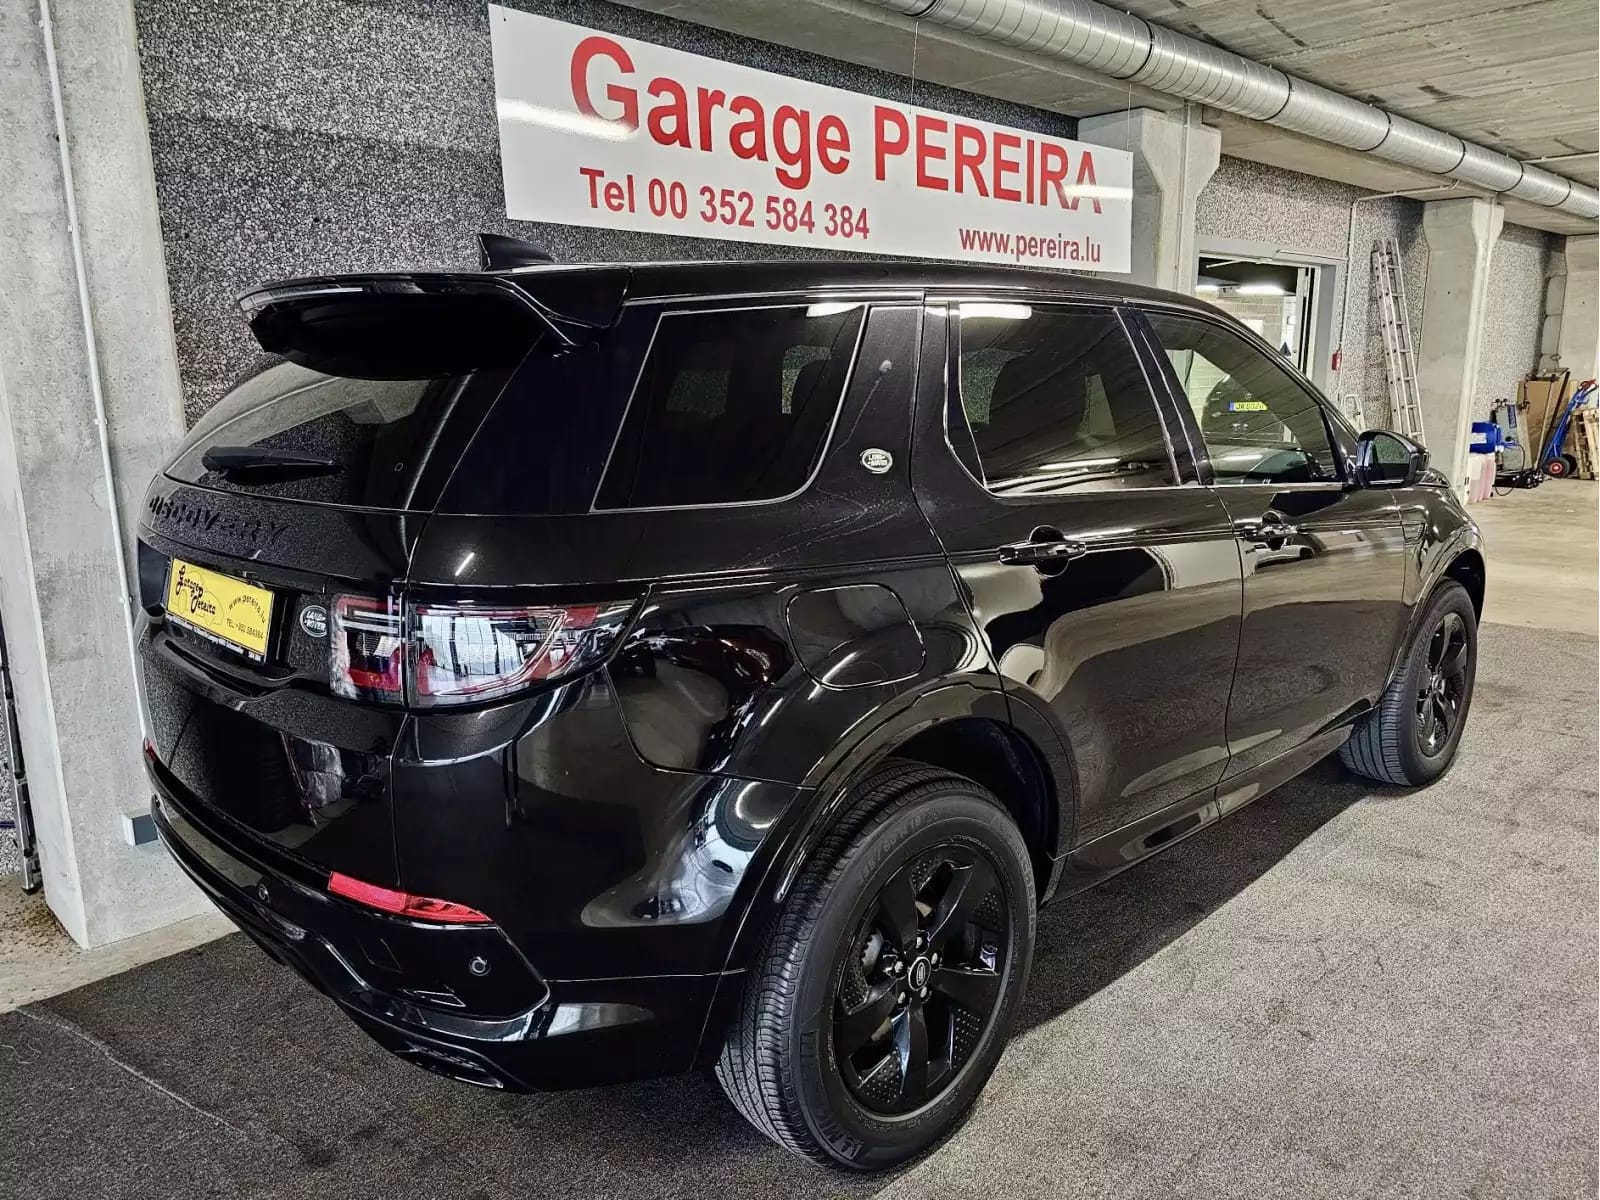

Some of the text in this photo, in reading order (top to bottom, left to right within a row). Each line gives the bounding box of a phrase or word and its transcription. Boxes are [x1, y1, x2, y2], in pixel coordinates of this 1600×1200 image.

[570, 35, 1103, 215] Garage PEREIRA
[579, 166, 870, 241] Tel 00 352 584 384
[958, 226, 1101, 265] www.pereira.lu
